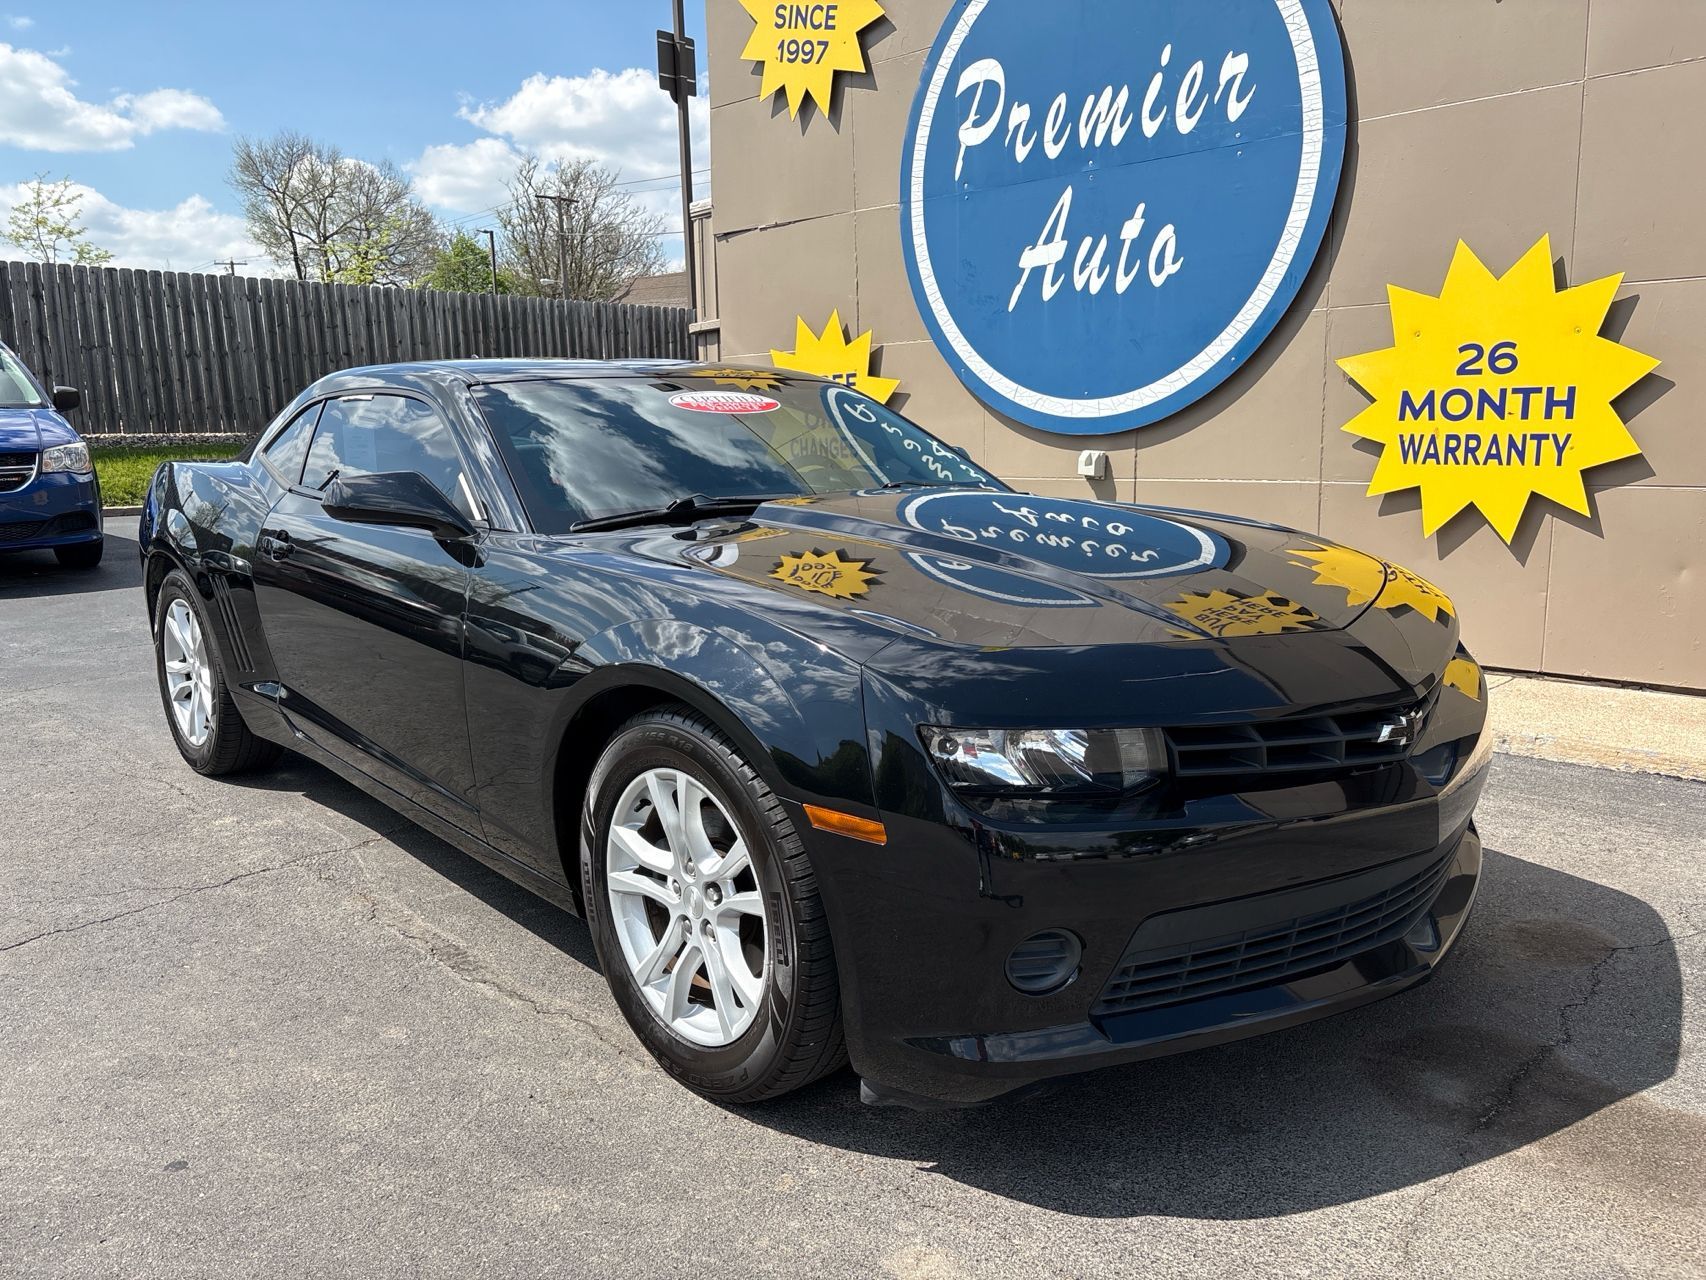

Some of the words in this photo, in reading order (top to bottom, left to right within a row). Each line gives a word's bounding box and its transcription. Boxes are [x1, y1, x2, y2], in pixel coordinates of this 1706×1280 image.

[774, 4, 838, 30] SINCE
[777, 39, 829, 64] 1997
[955, 43, 1257, 182] Premier
[1007, 184, 1184, 312] Auto
[1456, 341, 1519, 376] 26
[1398, 386, 1577, 422] MONTH
[1398, 433, 1572, 466] WARRANTY
